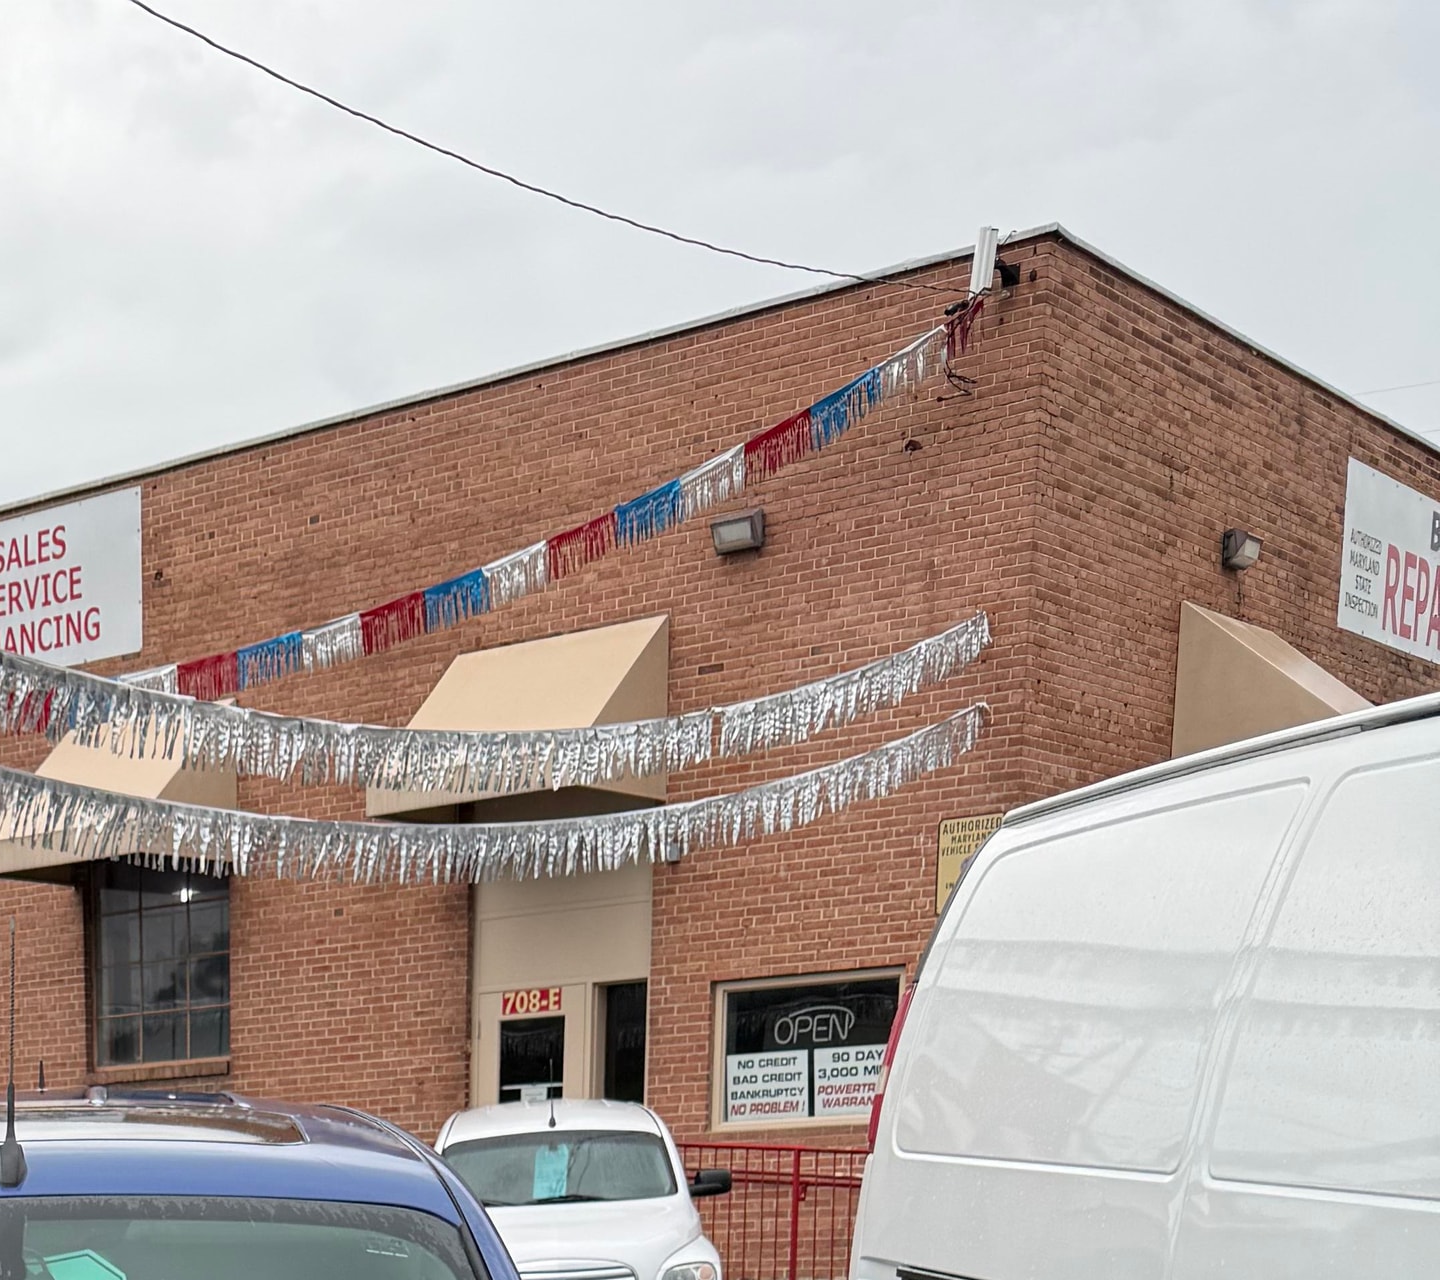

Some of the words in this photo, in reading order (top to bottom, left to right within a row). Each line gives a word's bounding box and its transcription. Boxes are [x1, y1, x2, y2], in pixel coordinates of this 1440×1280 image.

[1349, 549, 1380, 576] MARYLAND
[1355, 574, 1372, 595] STATE
[1382, 543, 1440, 651] REPA
[1344, 592, 1378, 619] INSPECTION
[943, 817, 1002, 835] AUTHORIZED
[942, 844, 971, 857] VEHICLE
[504, 987, 560, 1015] 708-E
[774, 1013, 850, 1044] OPEN
[737, 1060, 754, 1070] NO
[758, 1057, 798, 1068] CREDIT
[832, 1052, 850, 1063] 90
[732, 1075, 758, 1085] BAD
[762, 1072, 802, 1083] CREDIT
[818, 1067, 858, 1081] 3,000
[731, 1087, 805, 1101] BANKRUPTCY
[817, 1082, 877, 1096] POWERTR
[730, 1104, 747, 1116] NO
[749, 1102, 799, 1115] PROBLEM
[822, 1096, 874, 1108] WARRAN
